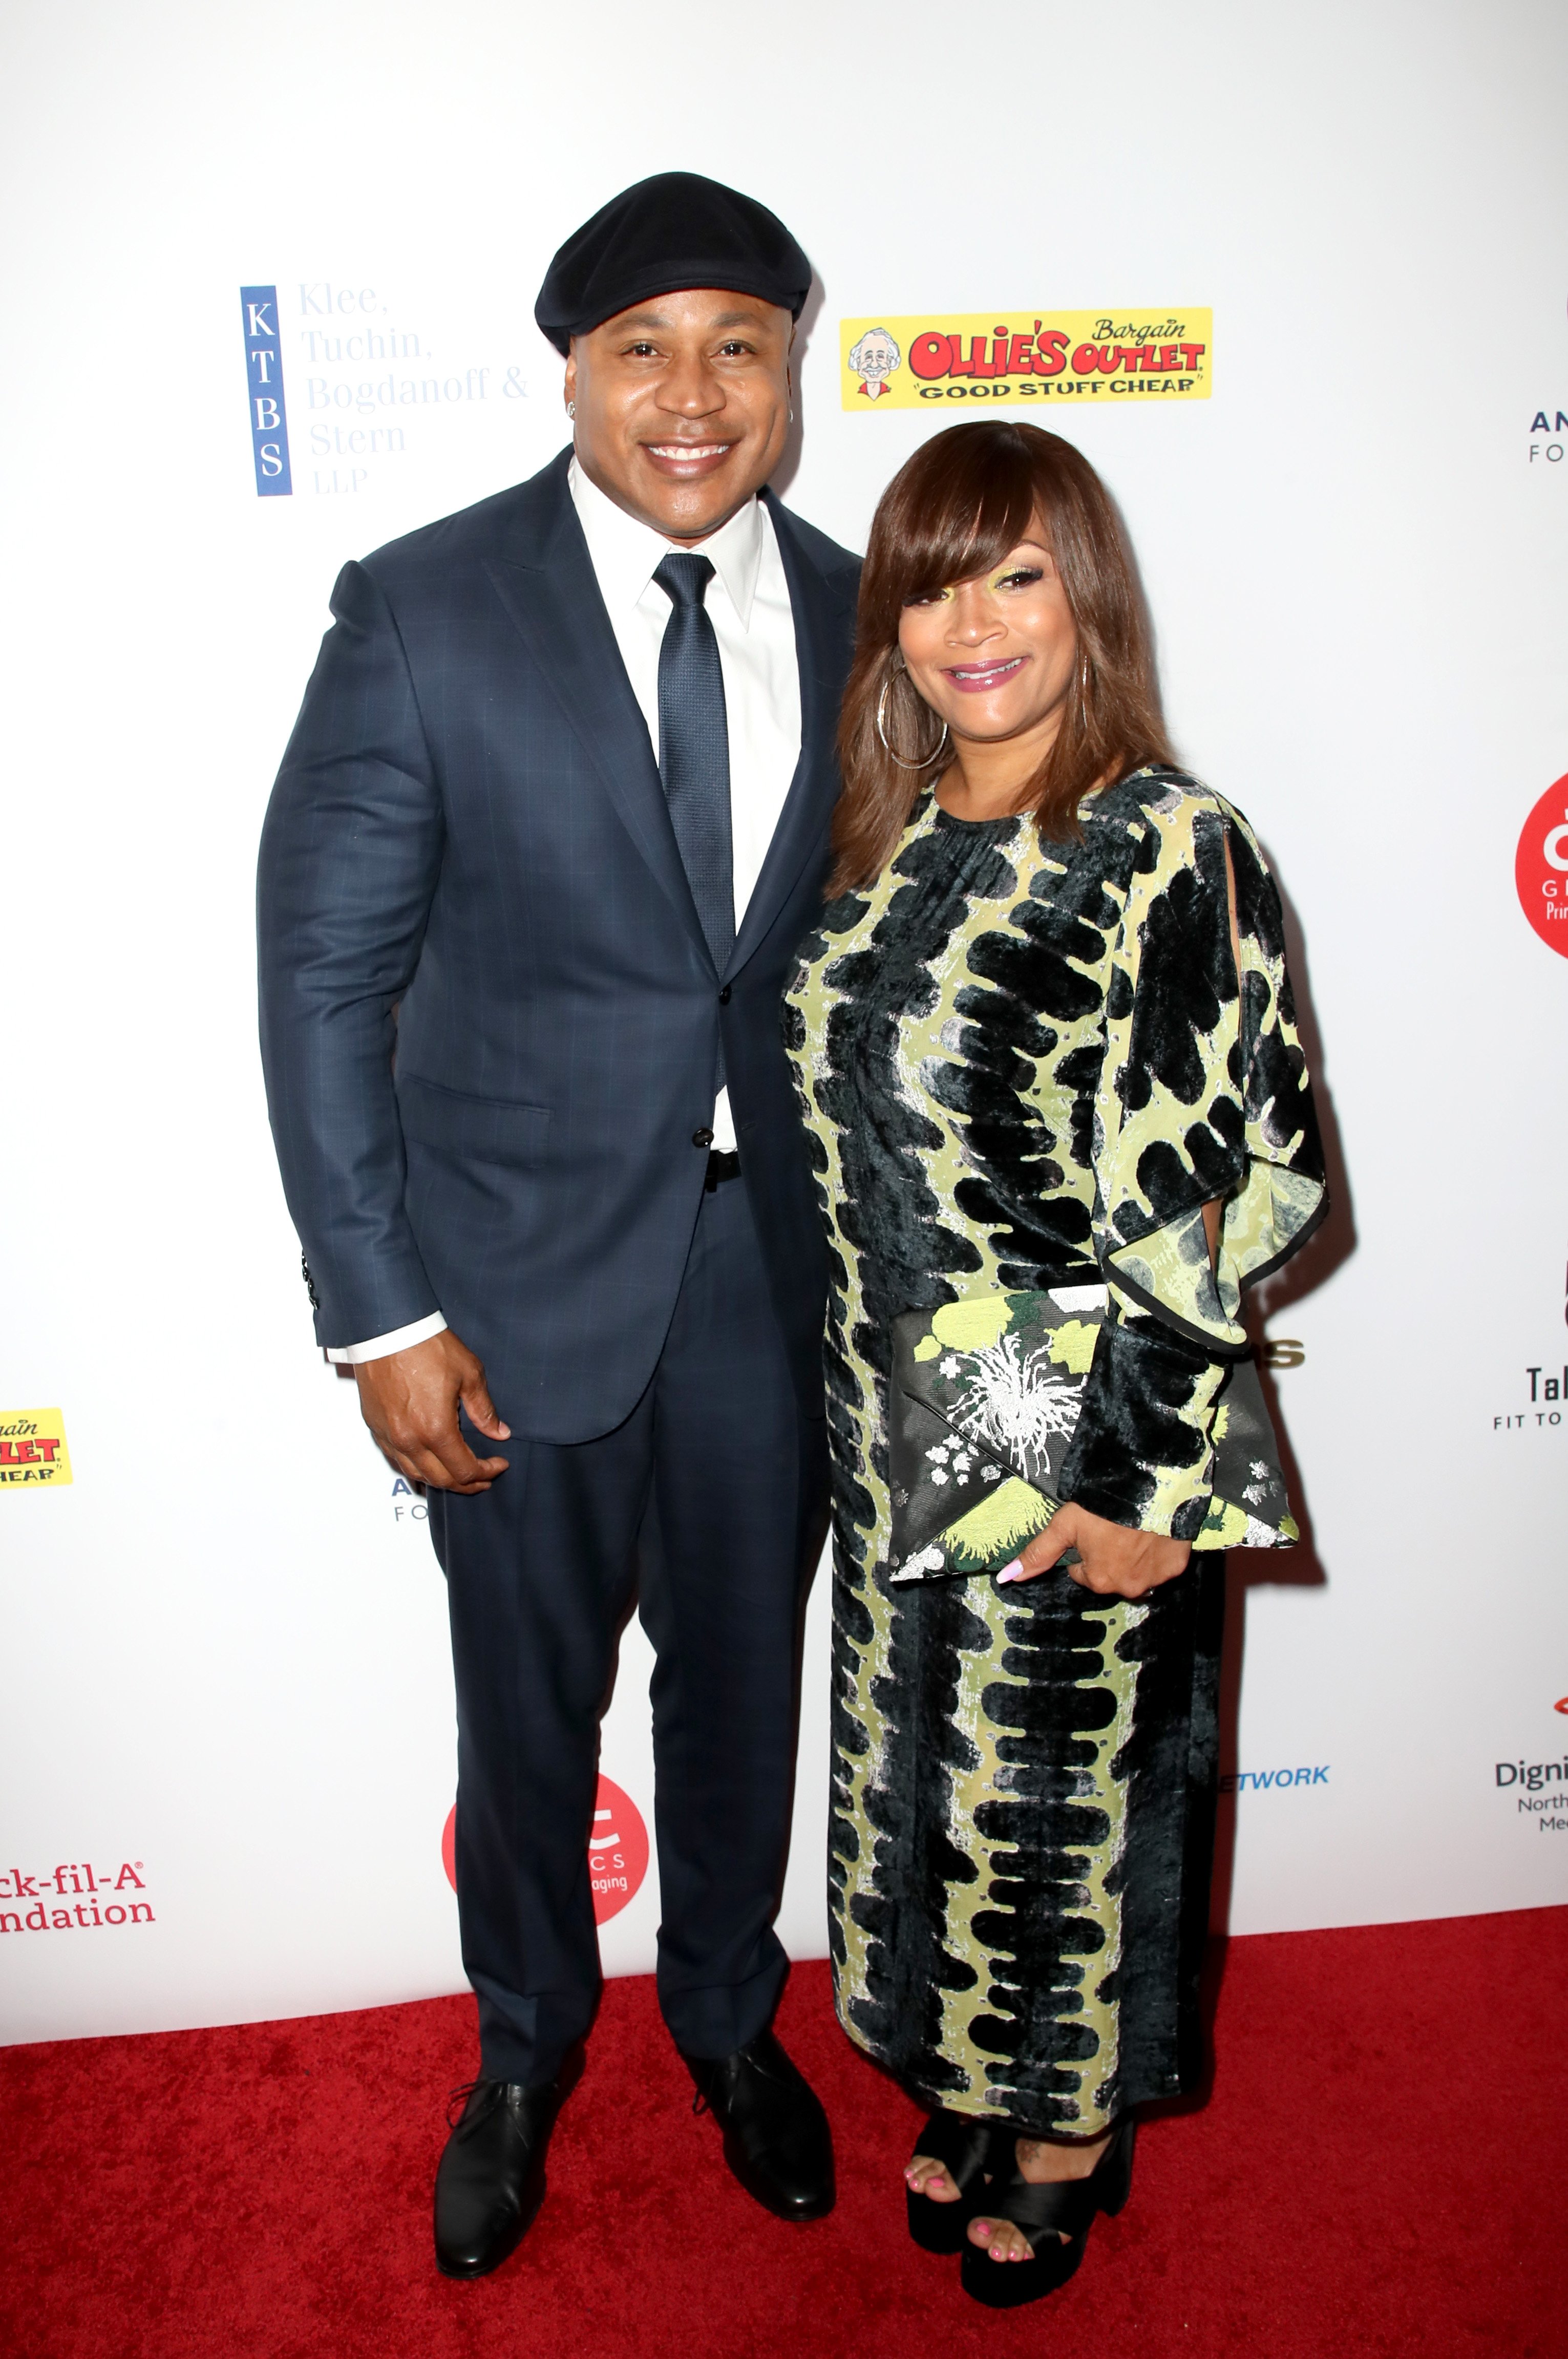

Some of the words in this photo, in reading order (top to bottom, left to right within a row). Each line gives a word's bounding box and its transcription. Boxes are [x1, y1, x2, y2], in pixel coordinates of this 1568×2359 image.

[297, 282, 388, 316] Klee,
[301, 327, 432, 363] Tuchin,
[1092, 318, 1186, 347] Bargain
[1071, 343, 1205, 375] OUTLET
[247, 303, 283, 477] KTBS
[306, 368, 490, 415] Bogdanoff
[502, 366, 529, 399] &
[1019, 381, 1105, 395] STUFF
[310, 423, 408, 456] Stern
[312, 468, 368, 495] LLP
[1494, 1415, 1525, 1430] FIT
[1535, 1412, 1561, 1426] TO
